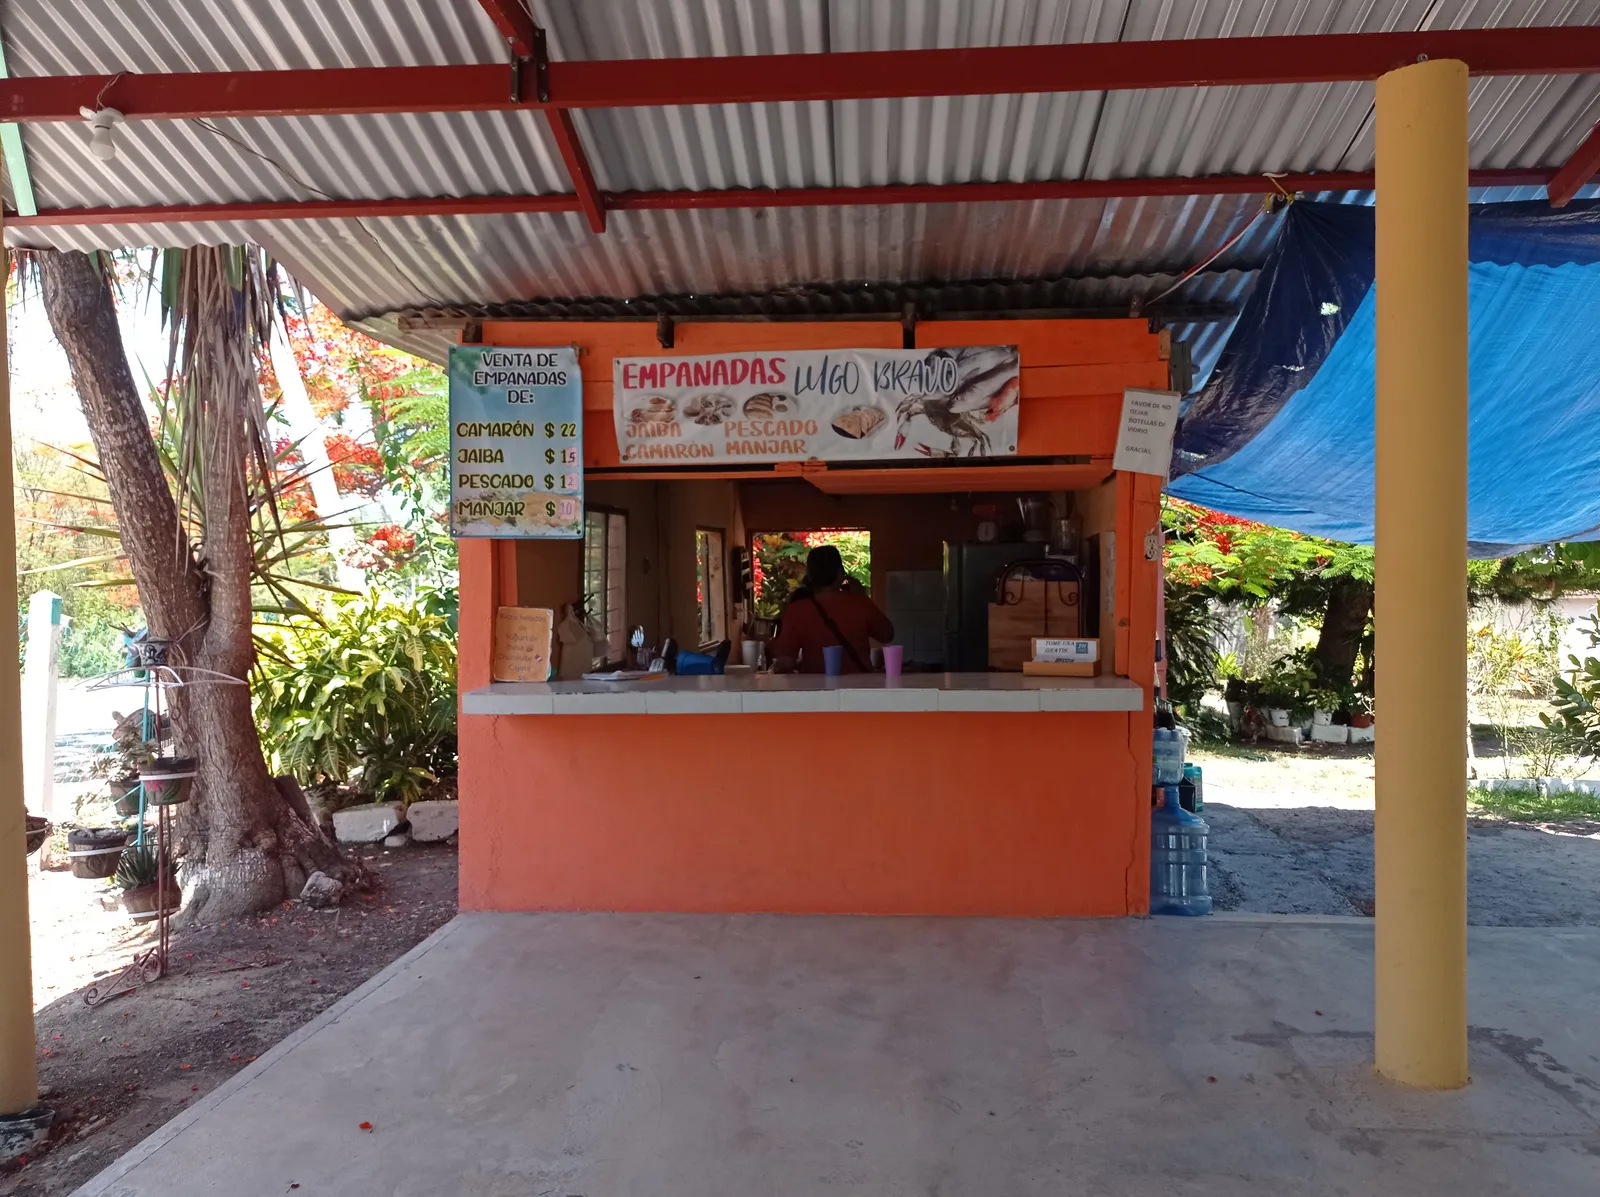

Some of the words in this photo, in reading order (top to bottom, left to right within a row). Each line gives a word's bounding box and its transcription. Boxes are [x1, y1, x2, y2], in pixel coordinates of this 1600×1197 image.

[482, 353, 531, 367] VENTA
[537, 353, 558, 366] DE
[474, 371, 567, 386] EMPANADAS
[623, 358, 786, 389] EMPANADAS
[794, 355, 859, 395] LUGO
[873, 358, 957, 395] BRAVO
[507, 389, 535, 404] DE:
[1131, 400, 1151, 408] FAVOR
[456, 420, 534, 437] CAMARÓN
[544, 422, 554, 438] $
[560, 423, 576, 437] 22
[626, 421, 682, 438] JAIBA
[724, 420, 818, 437] PESCADO
[1128, 417, 1157, 426] BOTELLAS
[726, 439, 807, 455] MANJAR
[457, 448, 504, 463] JAIBA
[545, 448, 555, 464] $
[560, 449, 576, 463] 15
[458, 474, 534, 489] PESCADO
[544, 474, 554, 489] $
[458, 501, 525, 516] MANJAR
[545, 501, 556, 517] $
